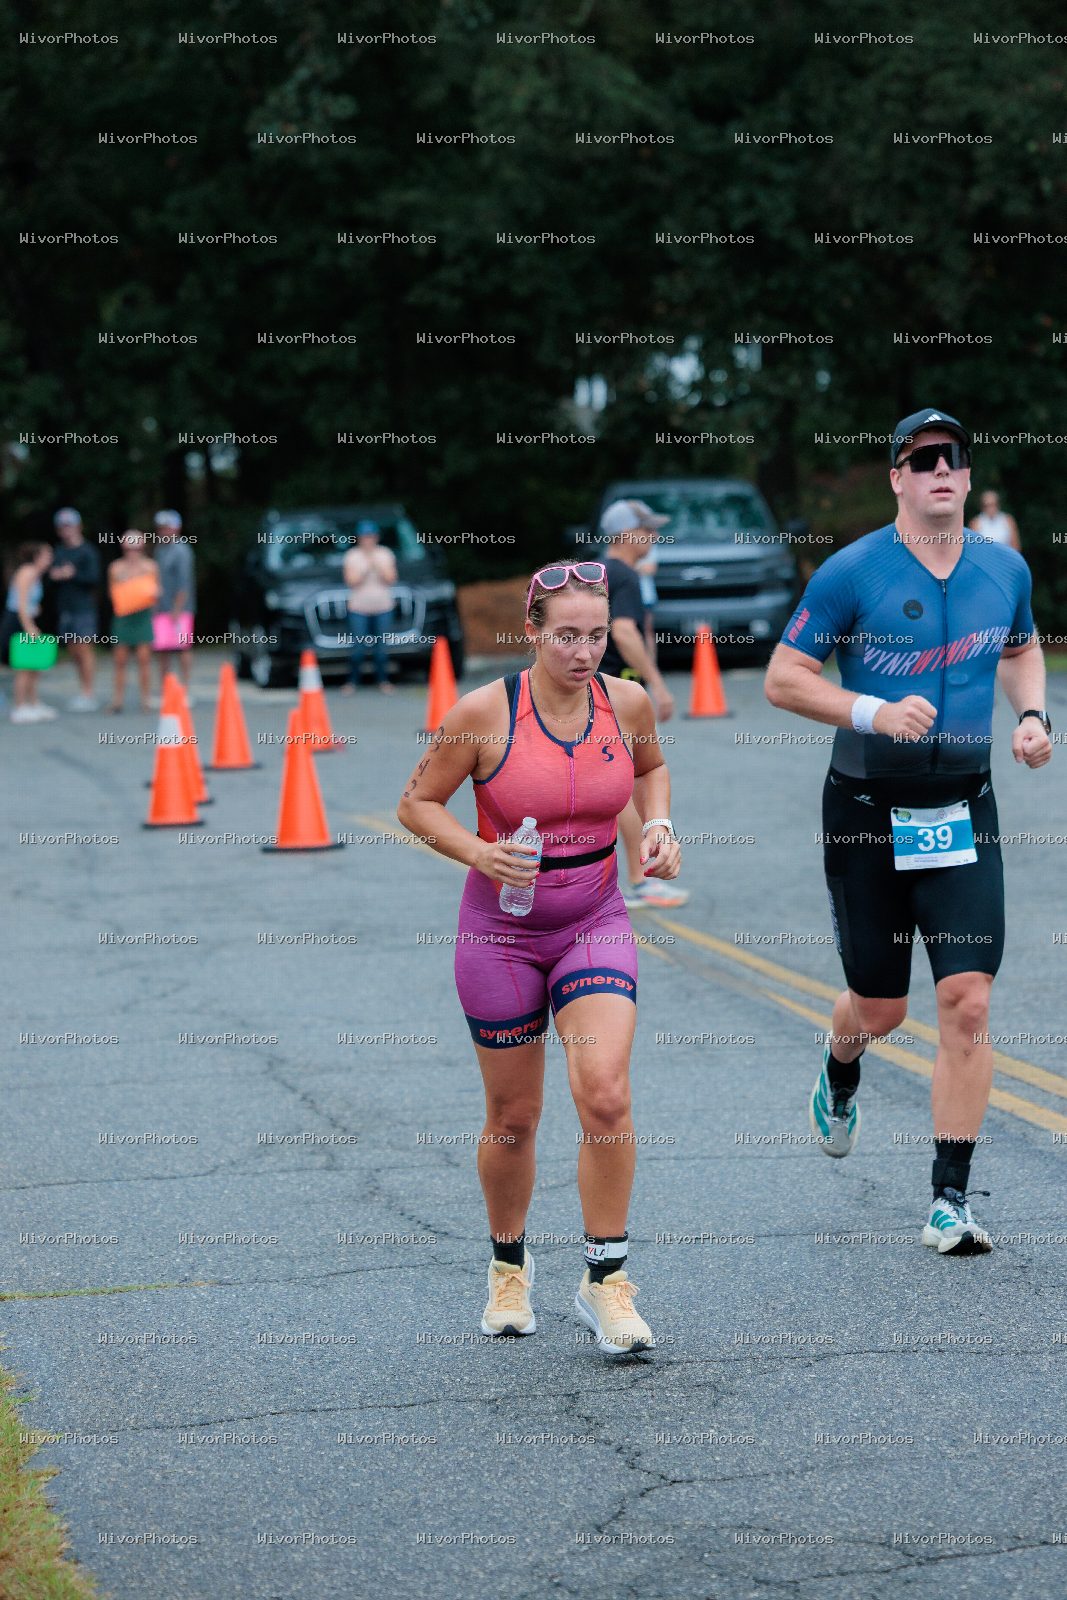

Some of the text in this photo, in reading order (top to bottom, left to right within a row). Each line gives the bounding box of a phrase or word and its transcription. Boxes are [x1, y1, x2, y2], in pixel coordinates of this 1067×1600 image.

[917, 825, 953, 852] 39
[561, 975, 634, 995] synergy
[479, 1015, 545, 1040] synergy
